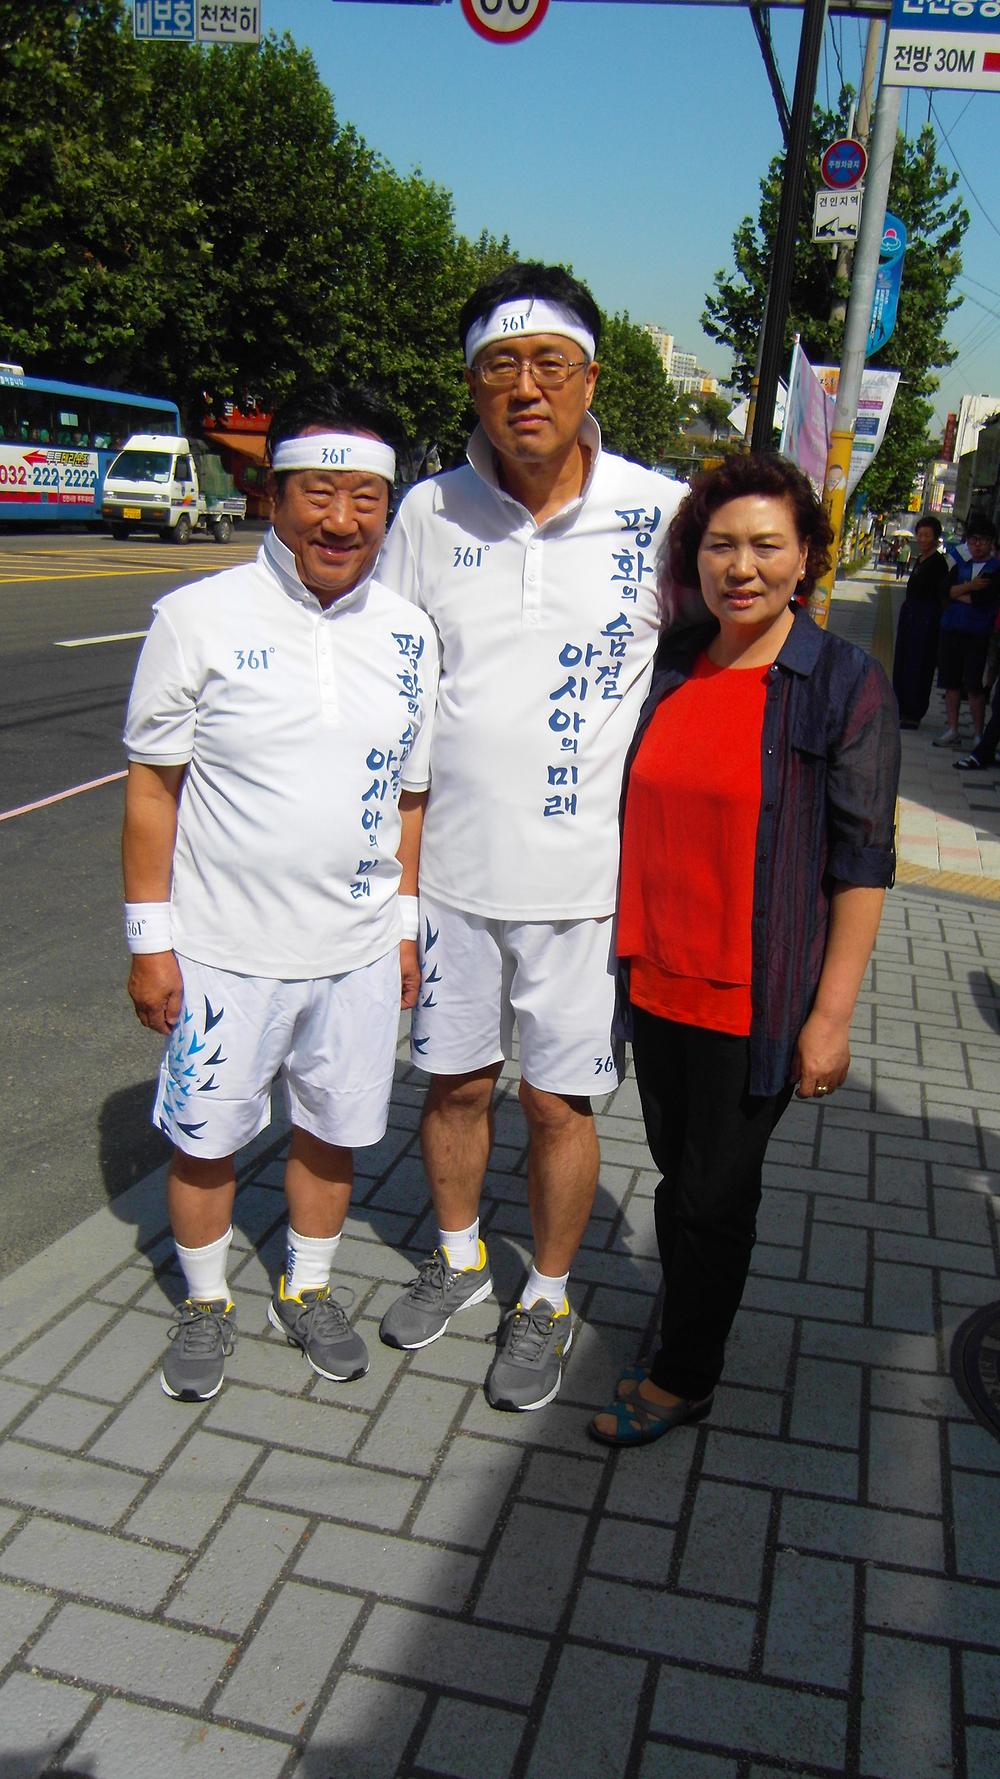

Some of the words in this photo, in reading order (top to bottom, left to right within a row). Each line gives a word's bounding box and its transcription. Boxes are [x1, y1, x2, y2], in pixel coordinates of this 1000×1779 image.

[201, 5, 257, 34] 천천히
[894, 45, 932, 73] 전방
[934, 48, 976, 73] 30M
[819, 195, 858, 208] 견인지역
[611, 506, 662, 603] 평화의
[595, 612, 634, 700] 숨결
[549, 643, 602, 754] 아시아의
[361, 747, 398, 848] 아시아의
[544, 765, 578, 817] 미래
